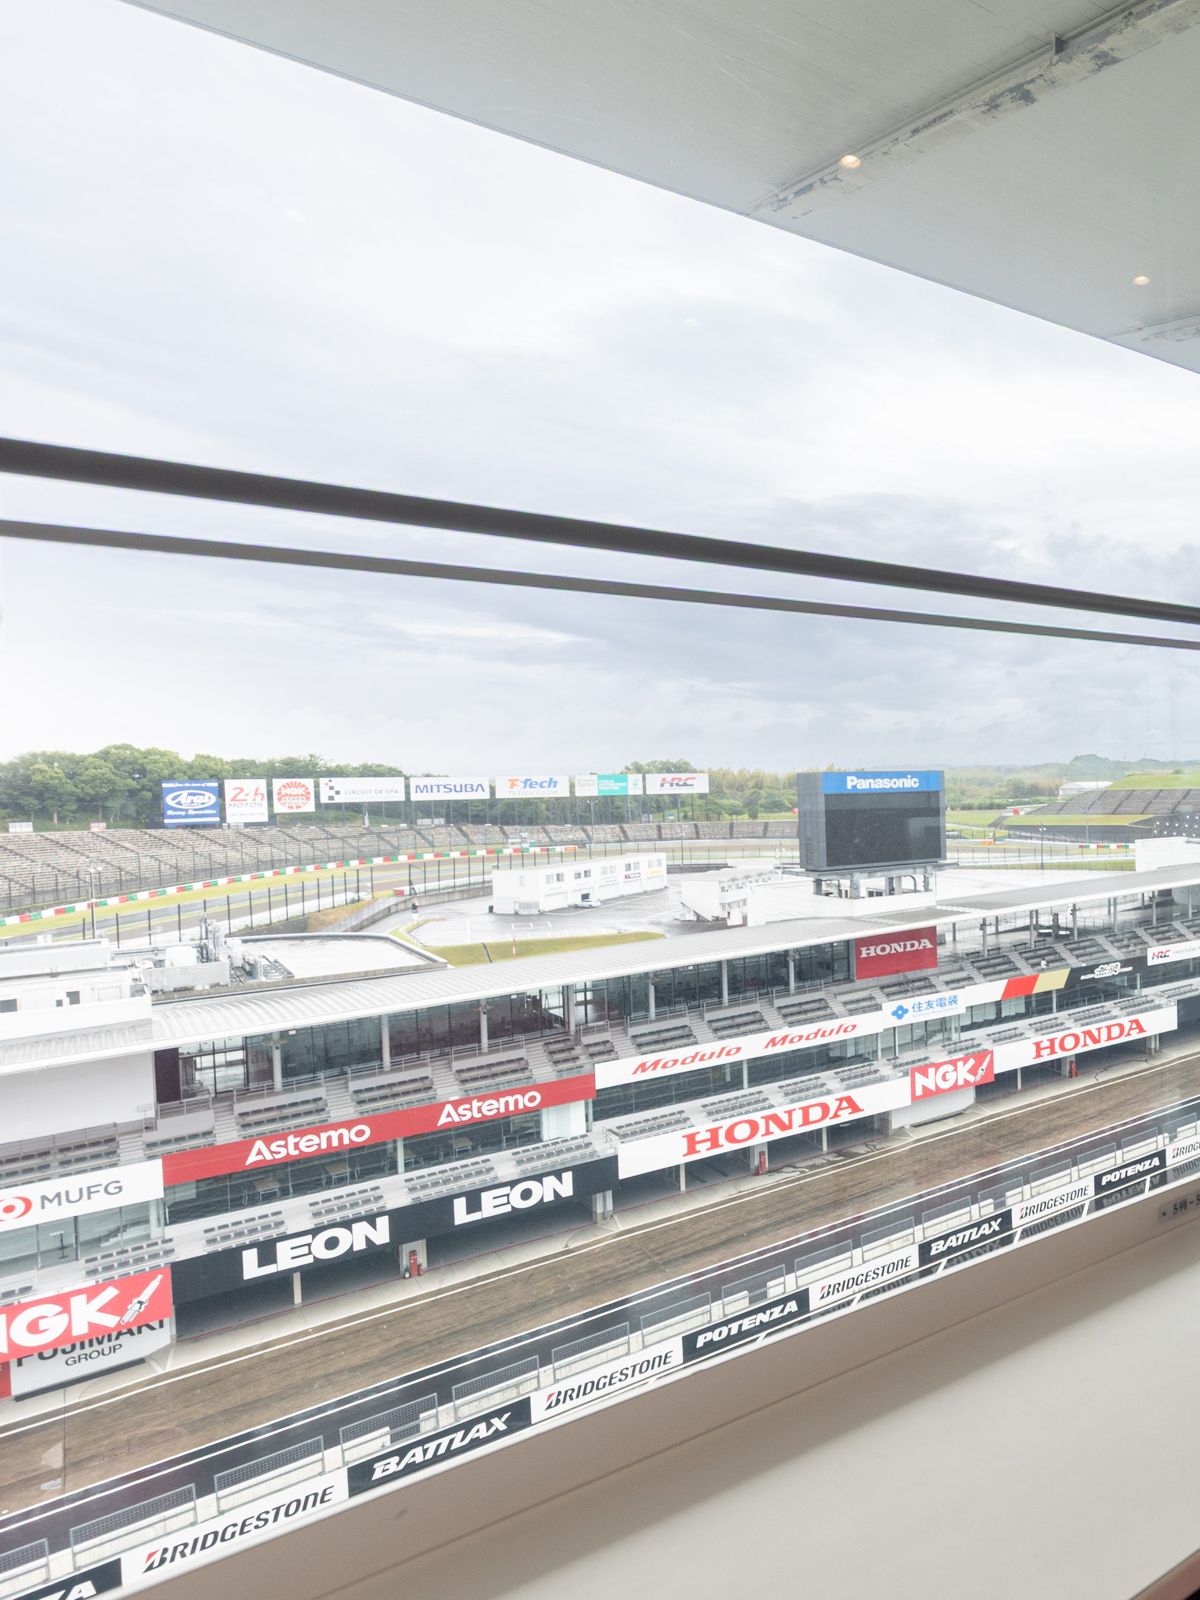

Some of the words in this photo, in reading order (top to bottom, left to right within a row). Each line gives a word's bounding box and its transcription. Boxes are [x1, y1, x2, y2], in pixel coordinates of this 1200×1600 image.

[415, 783, 486, 793] MITSUBA
[659, 776, 696, 787] HRC
[847, 775, 919, 789] Panasonic
[860, 938, 933, 958] HONDA
[764, 1023, 858, 1049] Modulo
[1033, 1018, 1147, 1060] HONDA
[632, 1045, 742, 1075] Modulo
[914, 1061, 977, 1096] NGK
[437, 1090, 542, 1127] Astemo
[682, 1095, 864, 1157] HONDA
[245, 1124, 371, 1166] Astemo
[1101, 1156, 1160, 1186] POTENZA
[40, 1179, 123, 1210] MUFG
[454, 1170, 574, 1226] LEON
[1018, 1184, 1090, 1219] BRIDGESTONE
[242, 1215, 391, 1280] LEON
[930, 1217, 1003, 1256] BATTLAX
[819, 1255, 912, 1300] BRIDGESTONE
[0, 1286, 121, 1354] GK
[696, 1300, 798, 1349] POTENZA
[65, 1343, 123, 1367] GROUP
[545, 1350, 673, 1412] BRIDGESTONE
[371, 1412, 513, 1481] BATTLAX
[143, 1485, 335, 1574] BRIDGESTONE
